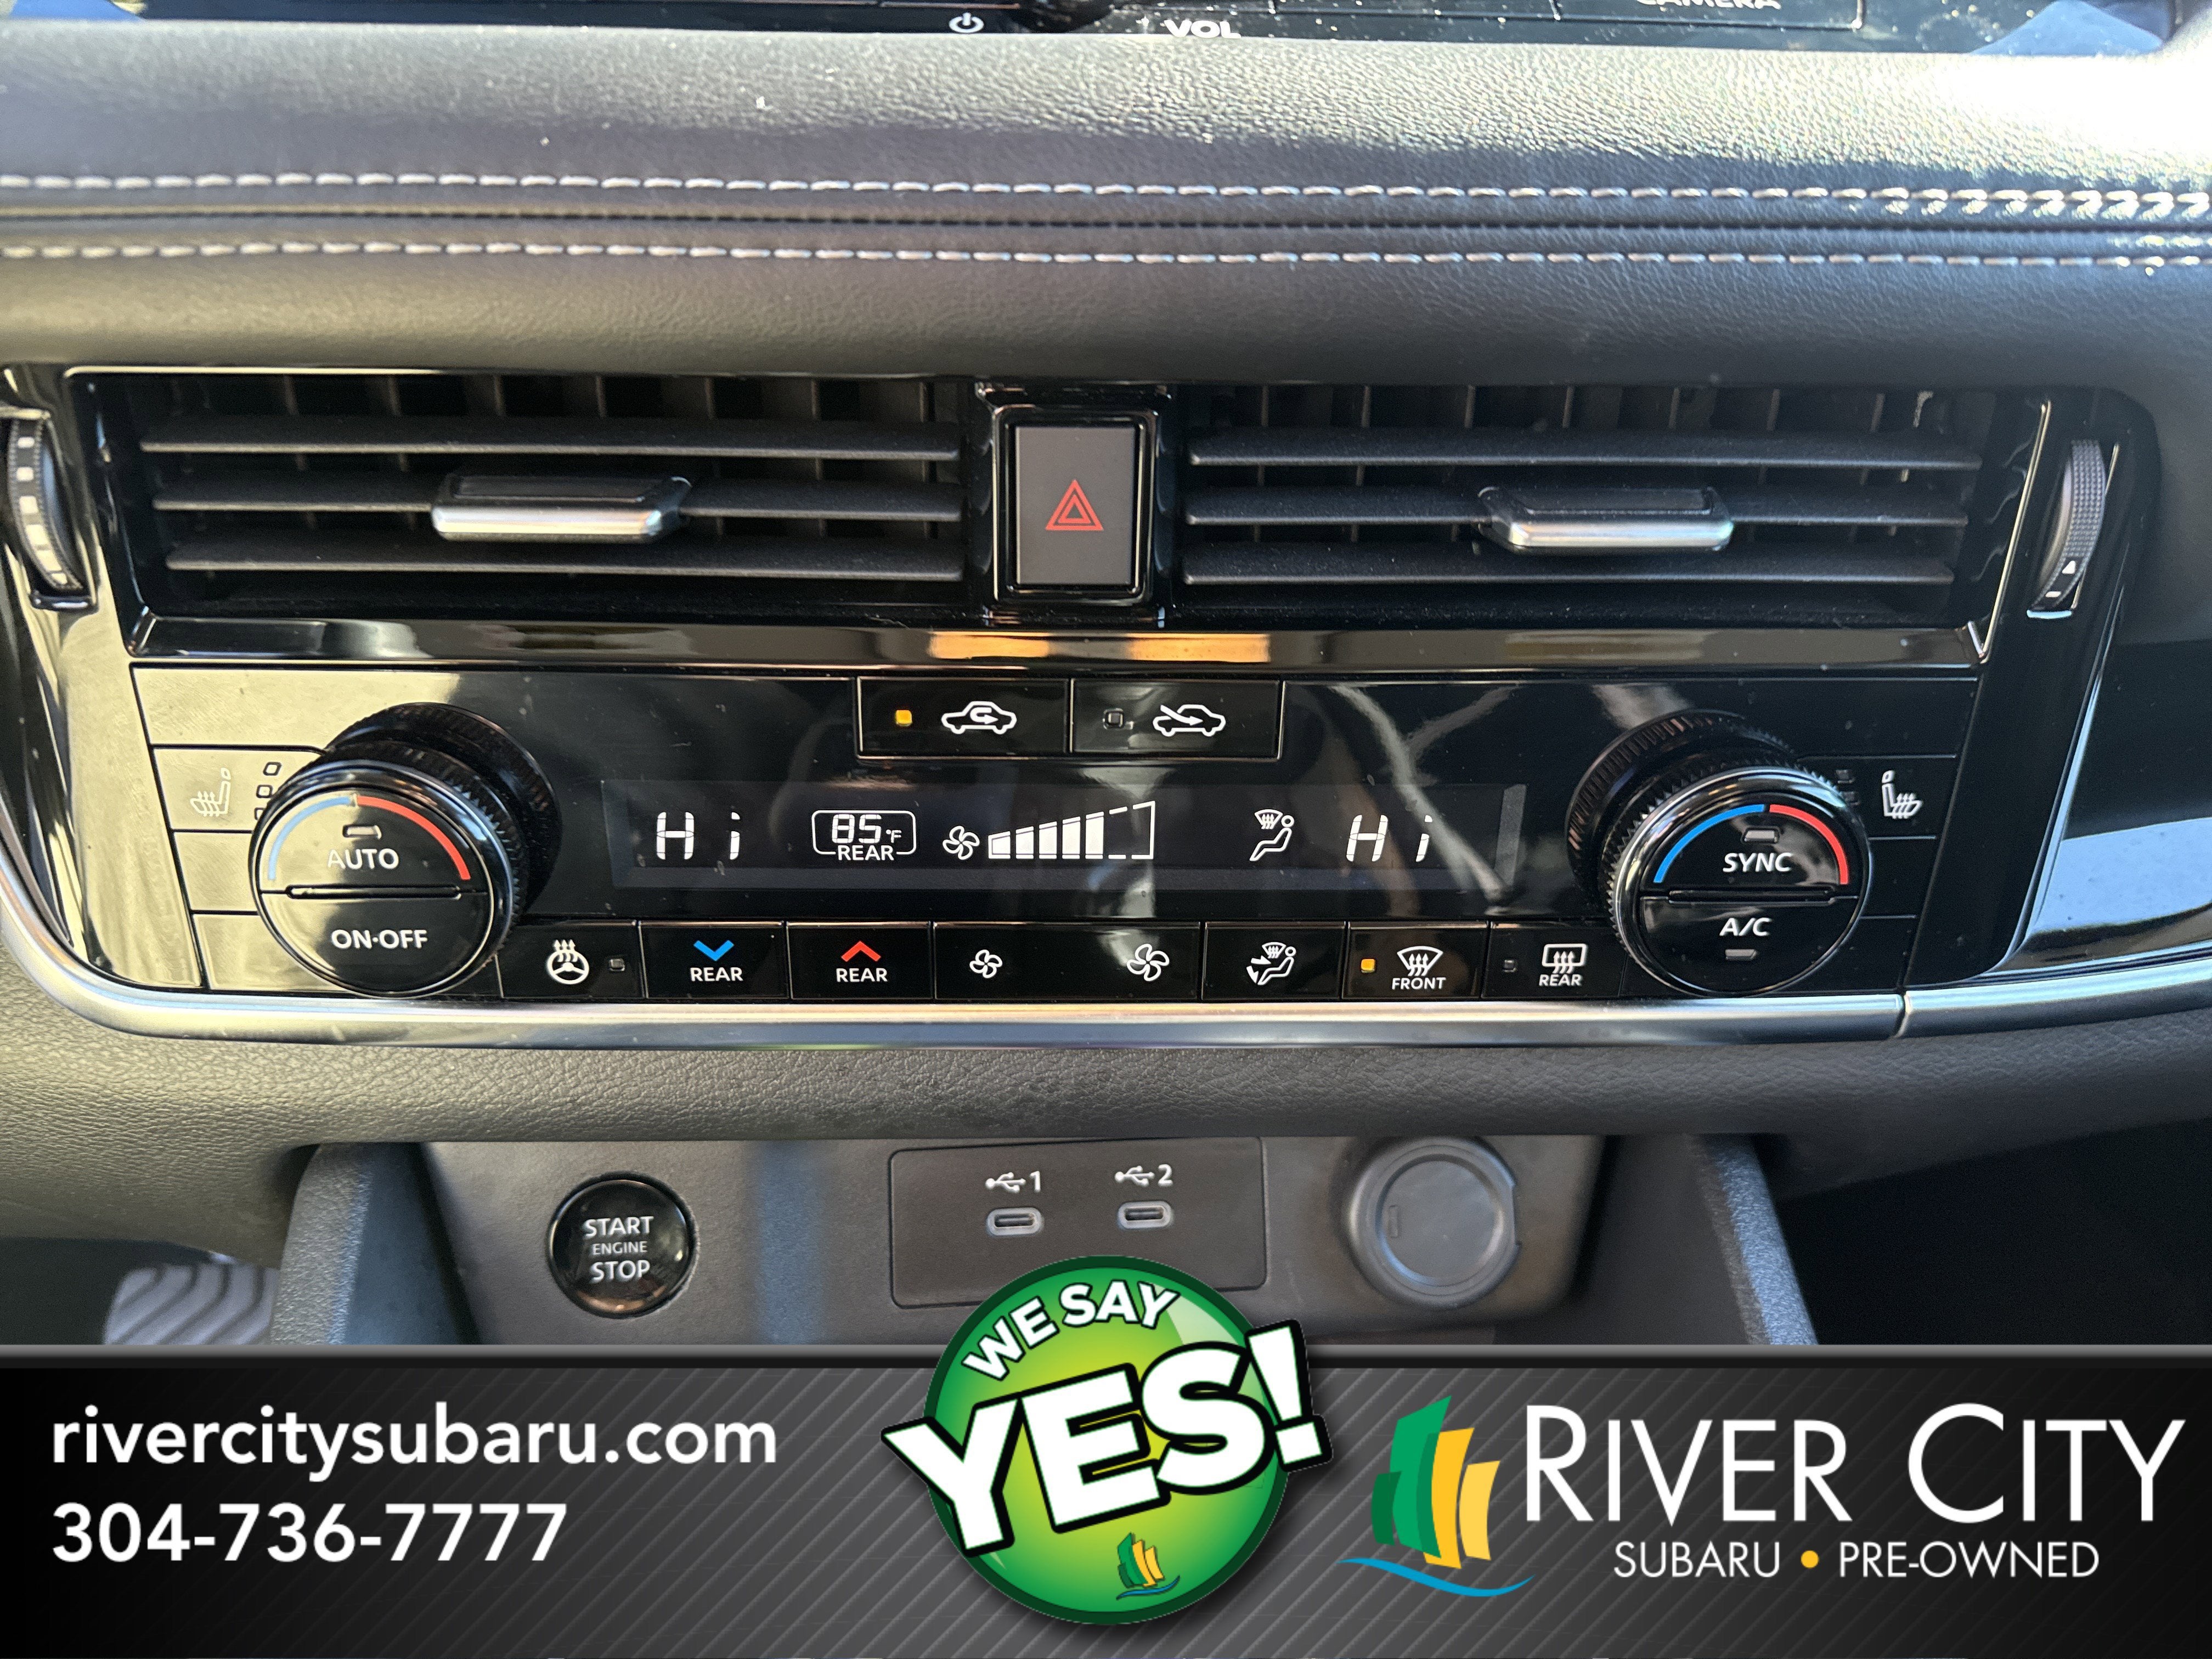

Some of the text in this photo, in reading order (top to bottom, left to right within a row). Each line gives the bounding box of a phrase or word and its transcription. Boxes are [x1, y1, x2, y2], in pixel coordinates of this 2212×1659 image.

[1637, 0, 1782, 10] ERA
[1164, 19, 1242, 39] VOL
[328, 848, 399, 870] AUTO
[837, 845, 894, 861] REAR
[1723, 852, 1793, 873] SYNC
[1719, 917, 1771, 936] A/C
[690, 966, 743, 982] REAR
[836, 967, 888, 983] REAR
[1391, 977, 1446, 990] FRONT
[1538, 974, 1582, 987] REAR
[1029, 1170, 1041, 1192] 1
[1158, 1164, 1173, 1187] 2
[582, 1216, 654, 1238] START
[591, 1240, 648, 1255] ENGINE
[590, 1260, 651, 1281] STOP
